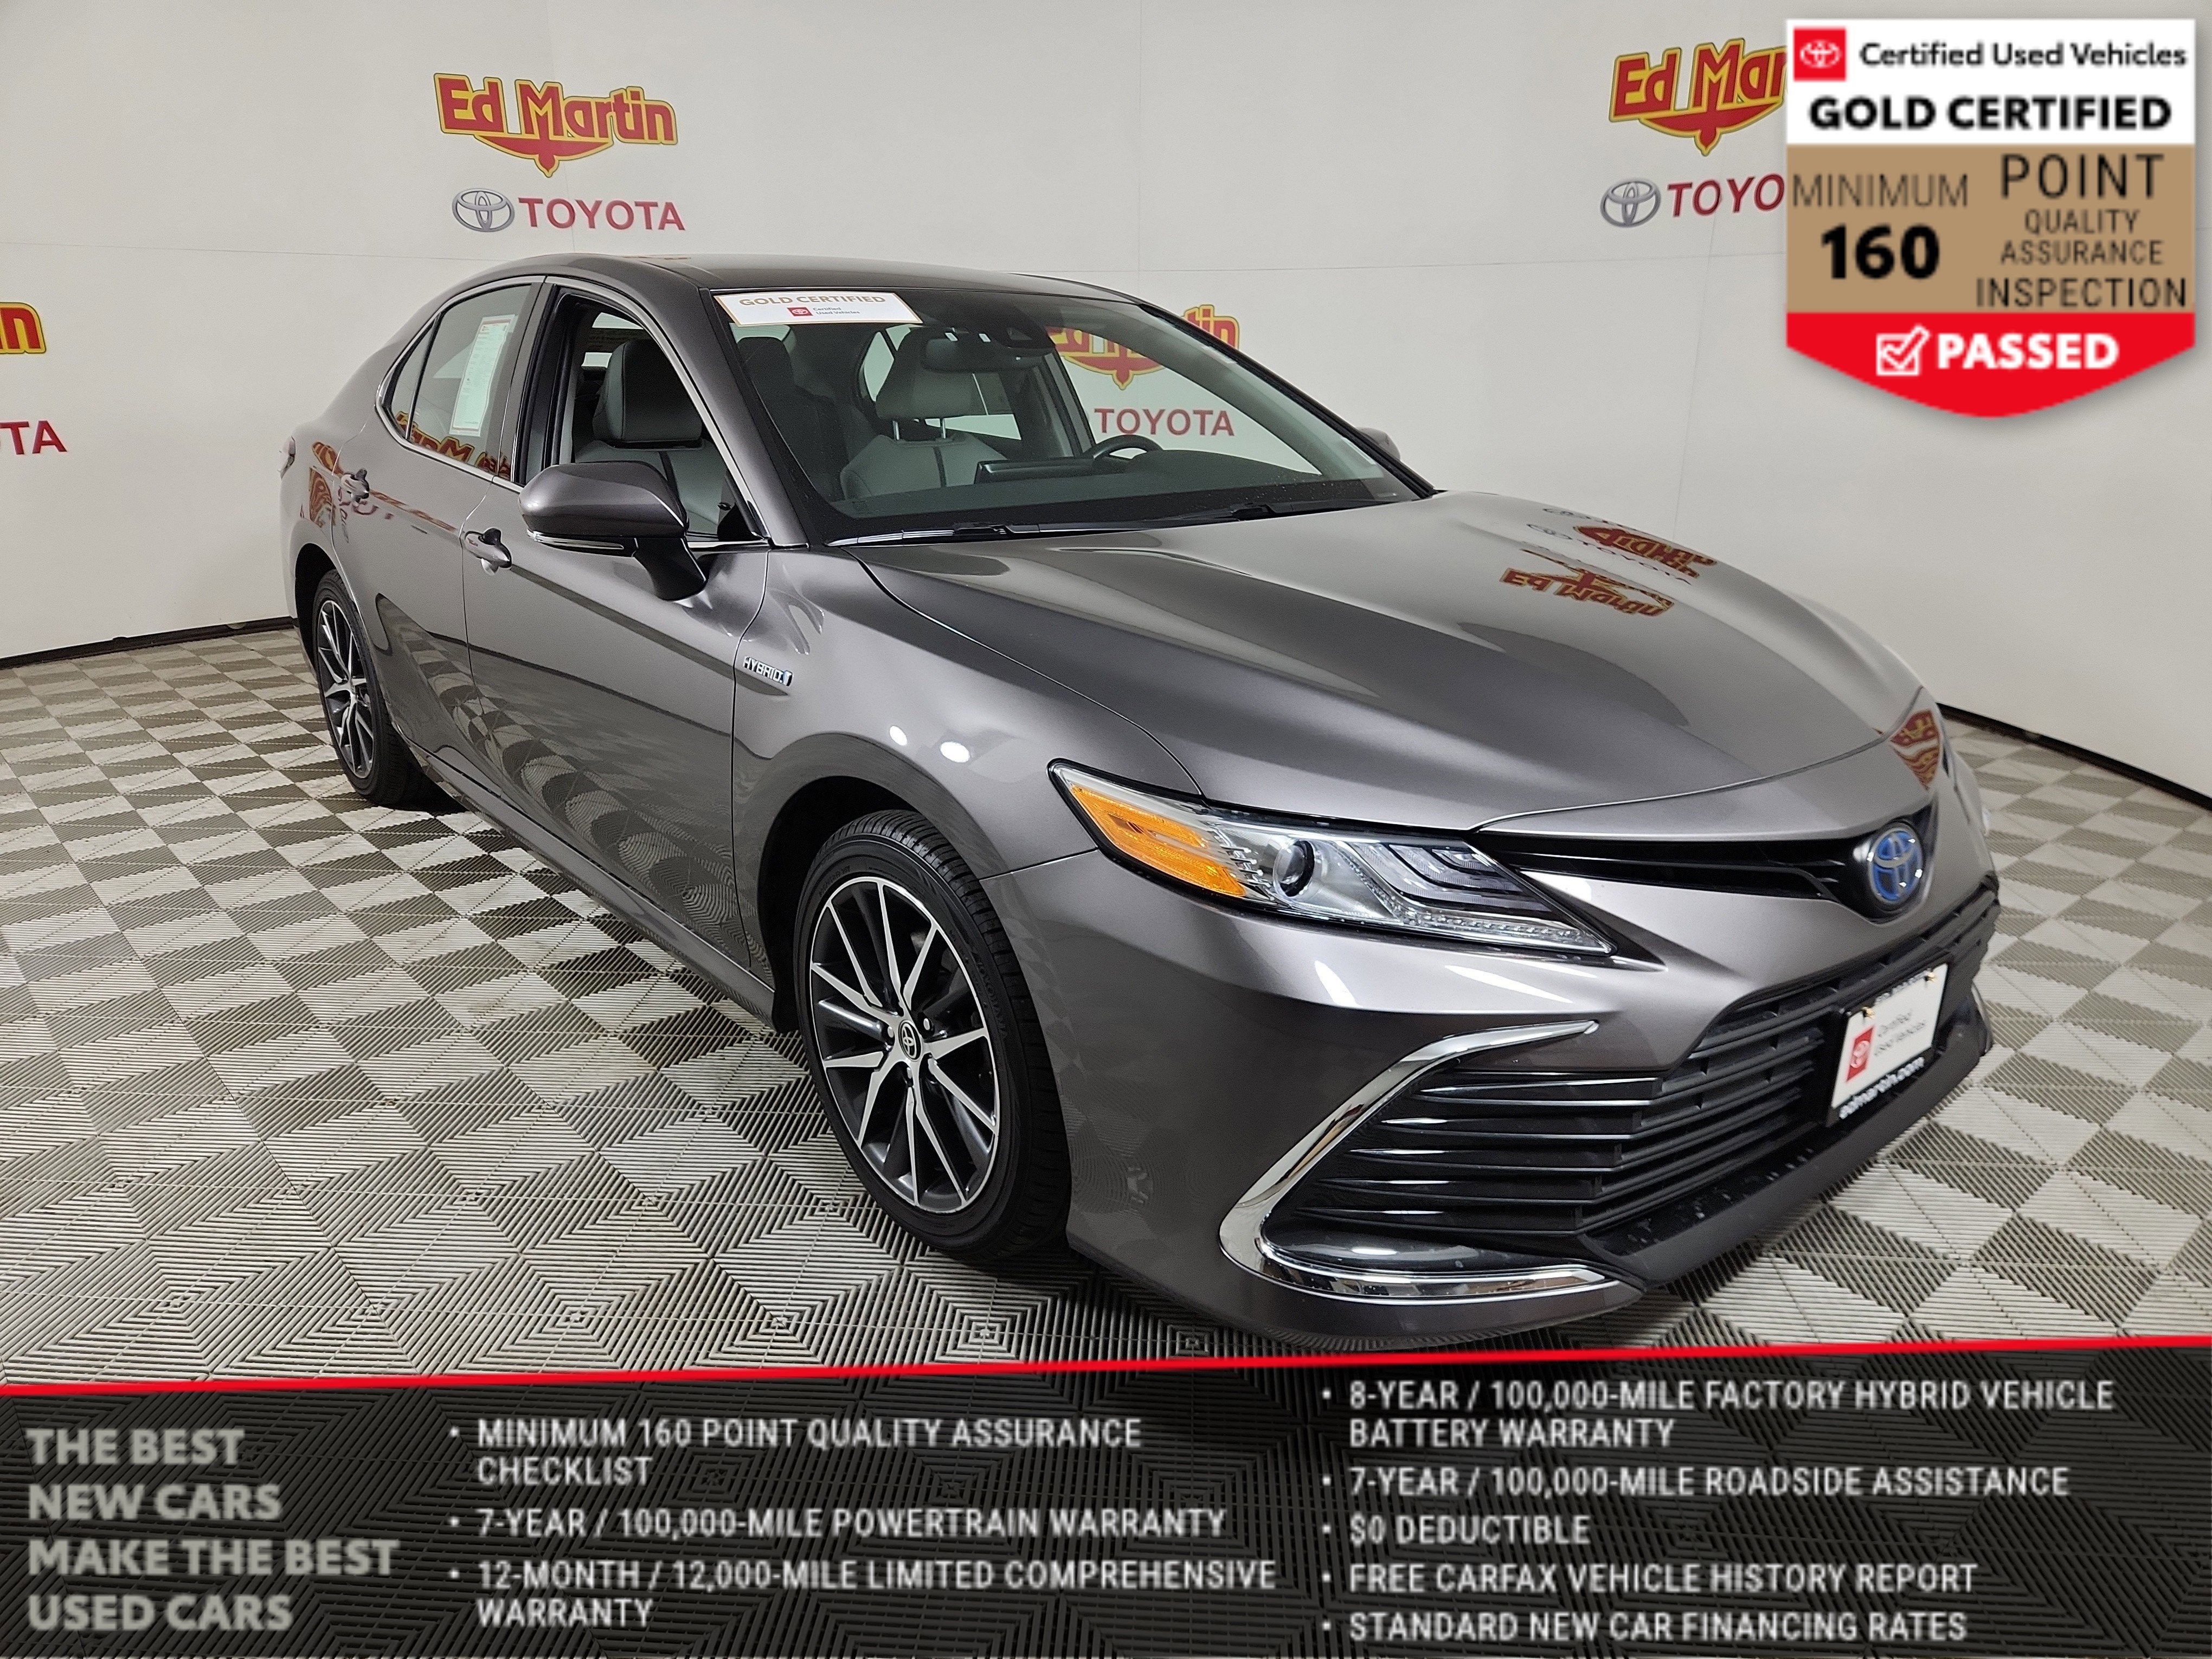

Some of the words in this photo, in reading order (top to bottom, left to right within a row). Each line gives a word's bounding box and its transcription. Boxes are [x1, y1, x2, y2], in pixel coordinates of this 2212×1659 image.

[1610, 48, 1681, 121] Ed
[434, 74, 506, 134] Ed
[515, 80, 678, 145] Martin
[518, 197, 686, 231] TOYOTA
[739, 297, 793, 306] GOLD
[0, 420, 67, 455] TA
[1094, 408, 1235, 436] TOYOTA
[743, 656, 783, 683] HYBRID
